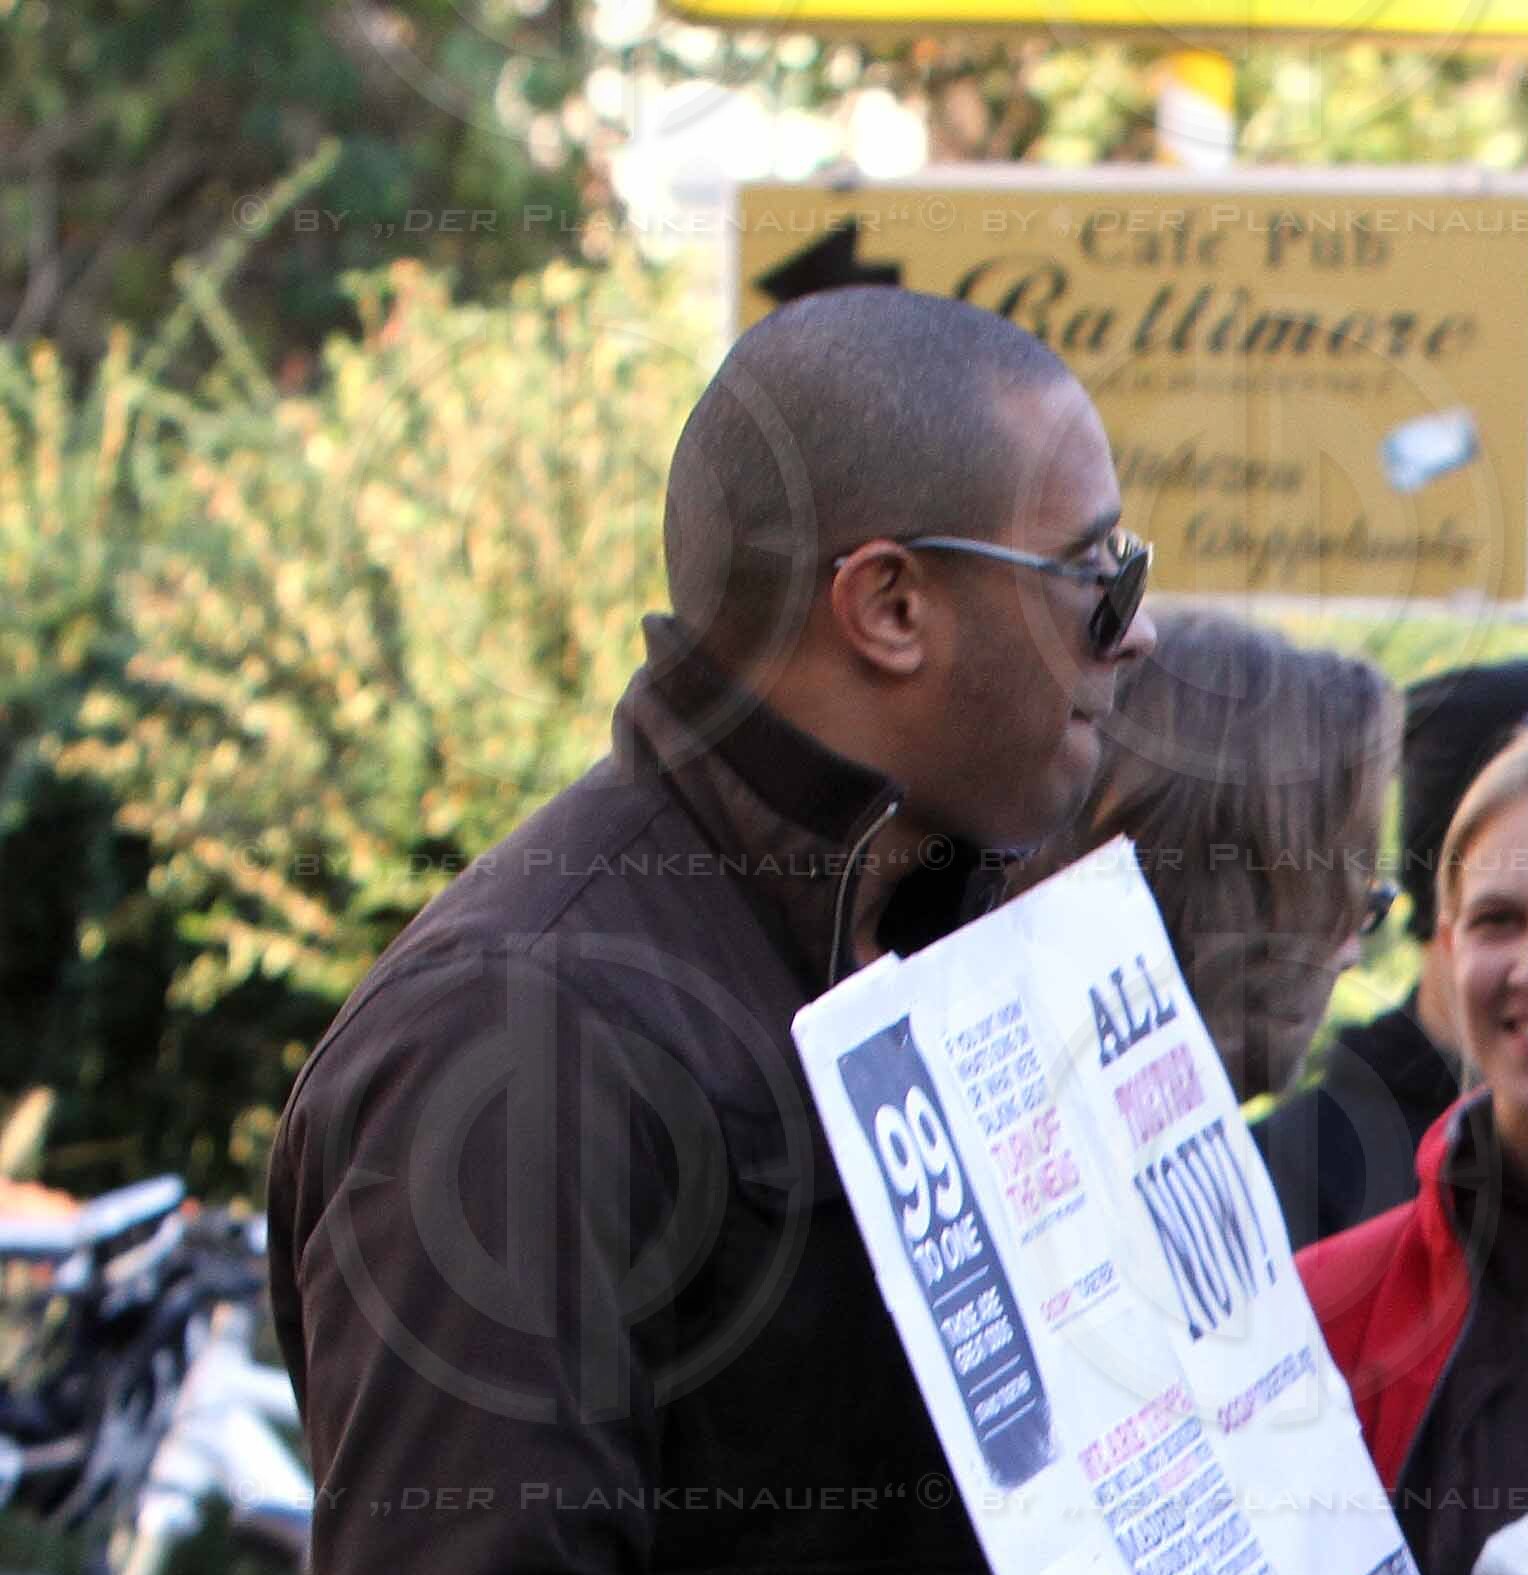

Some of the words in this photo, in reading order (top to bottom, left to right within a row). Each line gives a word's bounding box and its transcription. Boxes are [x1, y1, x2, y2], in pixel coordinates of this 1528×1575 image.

[1264, 206, 1392, 270] Pub
[1087, 955, 1178, 1067] ALL
[874, 1086, 964, 1242] 99
[986, 1124, 1039, 1185] TURN
[1027, 1104, 1071, 1159] OFF
[1003, 1173, 1046, 1229] THE
[1134, 1118, 1278, 1343] NOW!
[909, 1235, 948, 1289] TO
[933, 1209, 988, 1273] ONE
[937, 1300, 983, 1350] THOSE
[972, 1283, 1008, 1327] ARE
